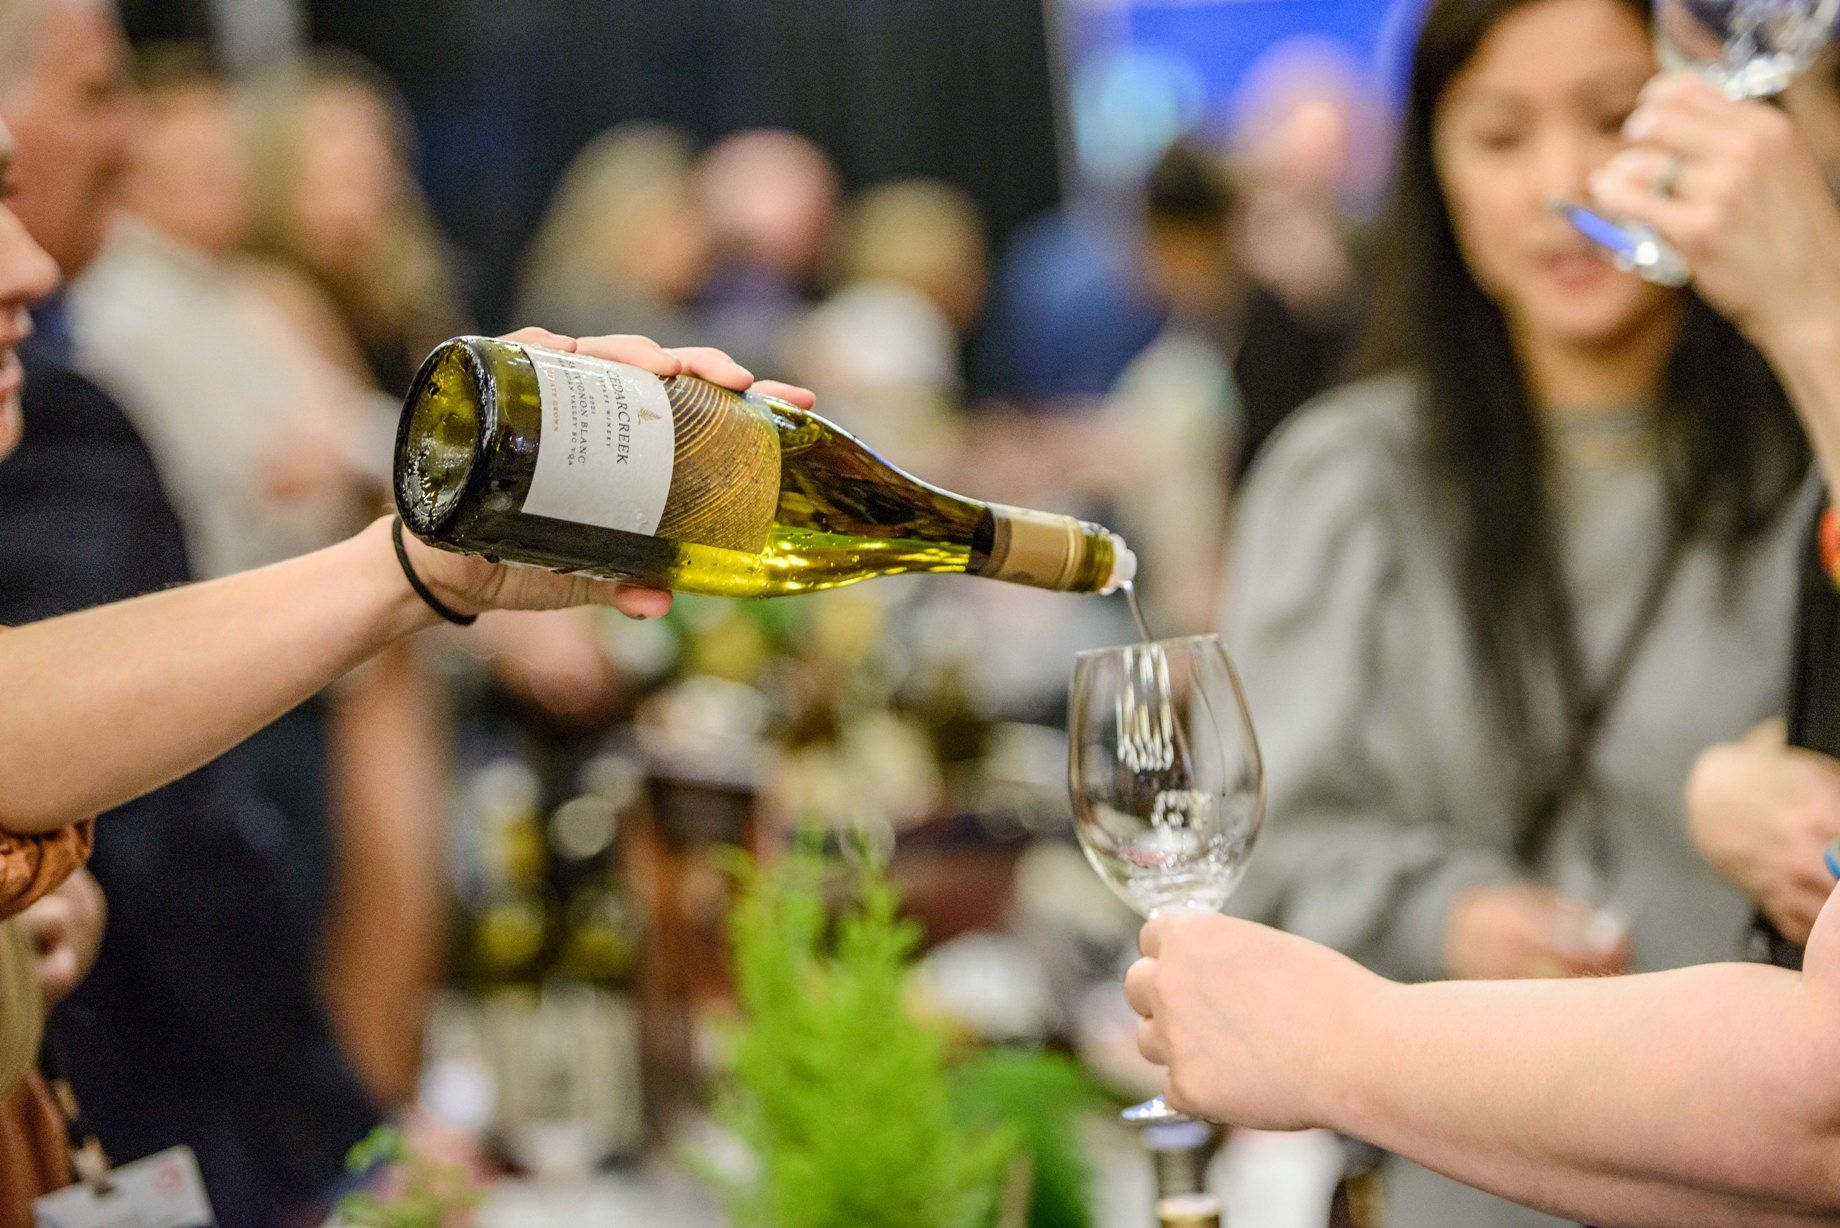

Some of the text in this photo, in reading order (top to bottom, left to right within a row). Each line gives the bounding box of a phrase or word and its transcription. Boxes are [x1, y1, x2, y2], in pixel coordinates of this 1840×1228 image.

[551, 401, 559, 433] GROWN
[568, 359, 589, 464] SAVIGNON BLANC
[570, 394, 578, 427] VALLEY
[606, 370, 631, 464] CEDARCREEK
[571, 431, 577, 443] BC
[568, 447, 576, 466] VQA
